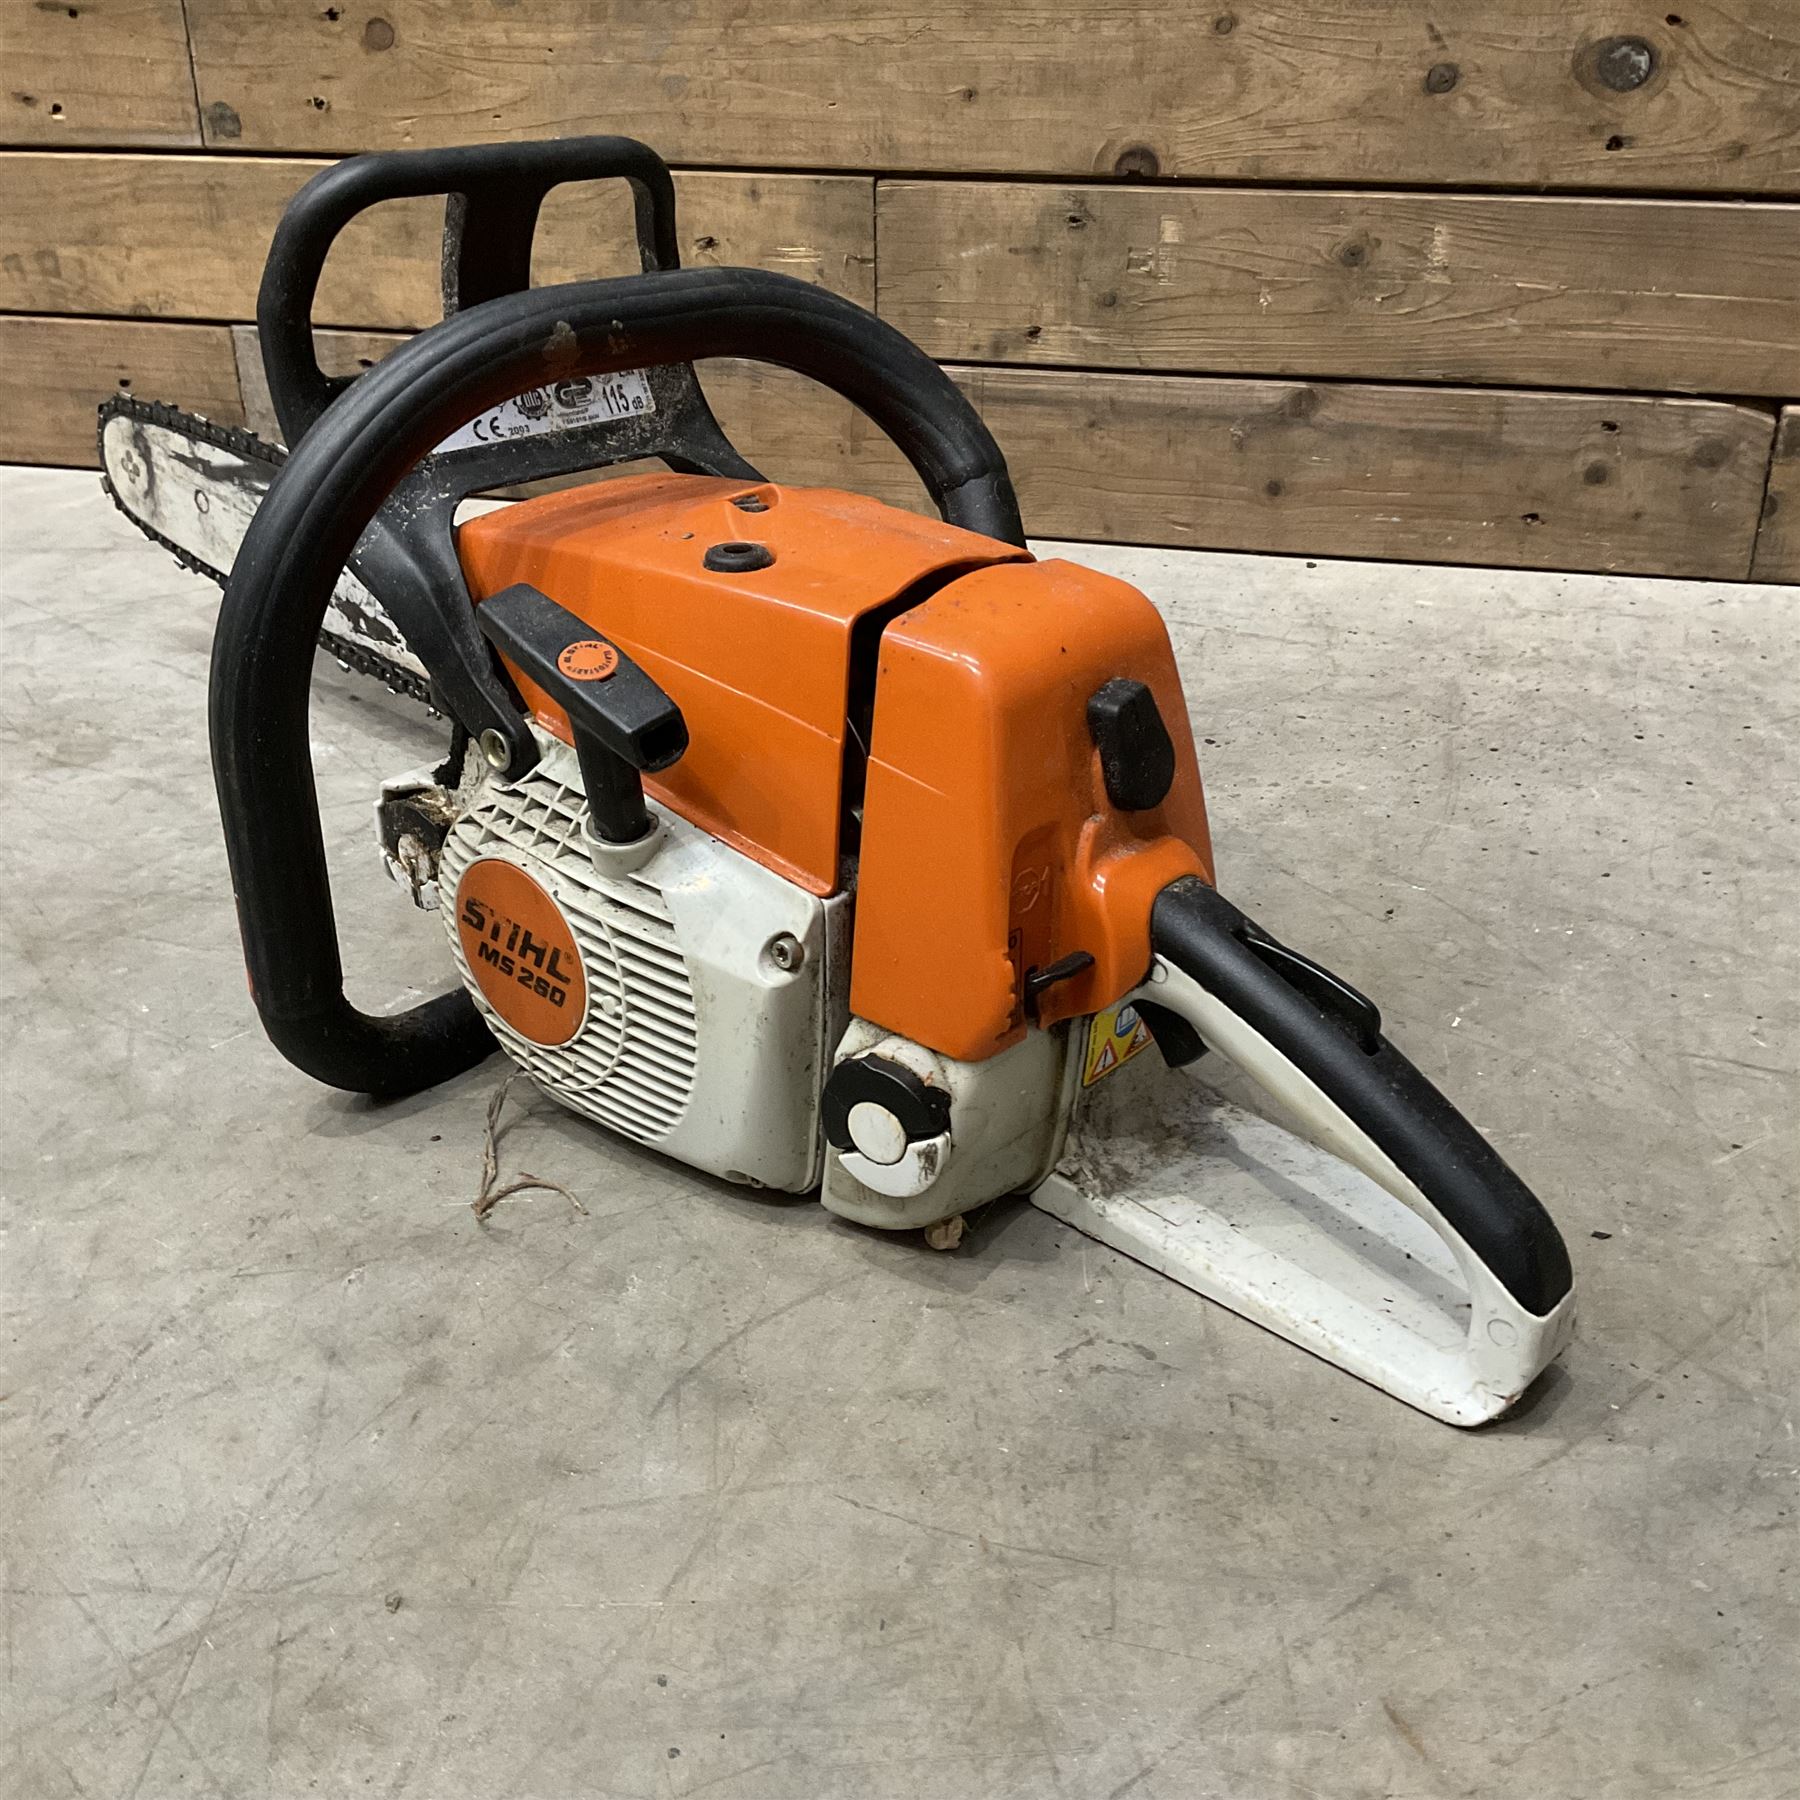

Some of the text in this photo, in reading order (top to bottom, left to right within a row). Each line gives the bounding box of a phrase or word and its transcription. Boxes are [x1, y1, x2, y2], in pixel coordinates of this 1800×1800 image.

[602, 384, 629, 415] 115
[632, 395, 644, 410] dB
[472, 416, 530, 441] CE 2003
[462, 896, 571, 986] STIHL
[478, 941, 515, 976] MS
